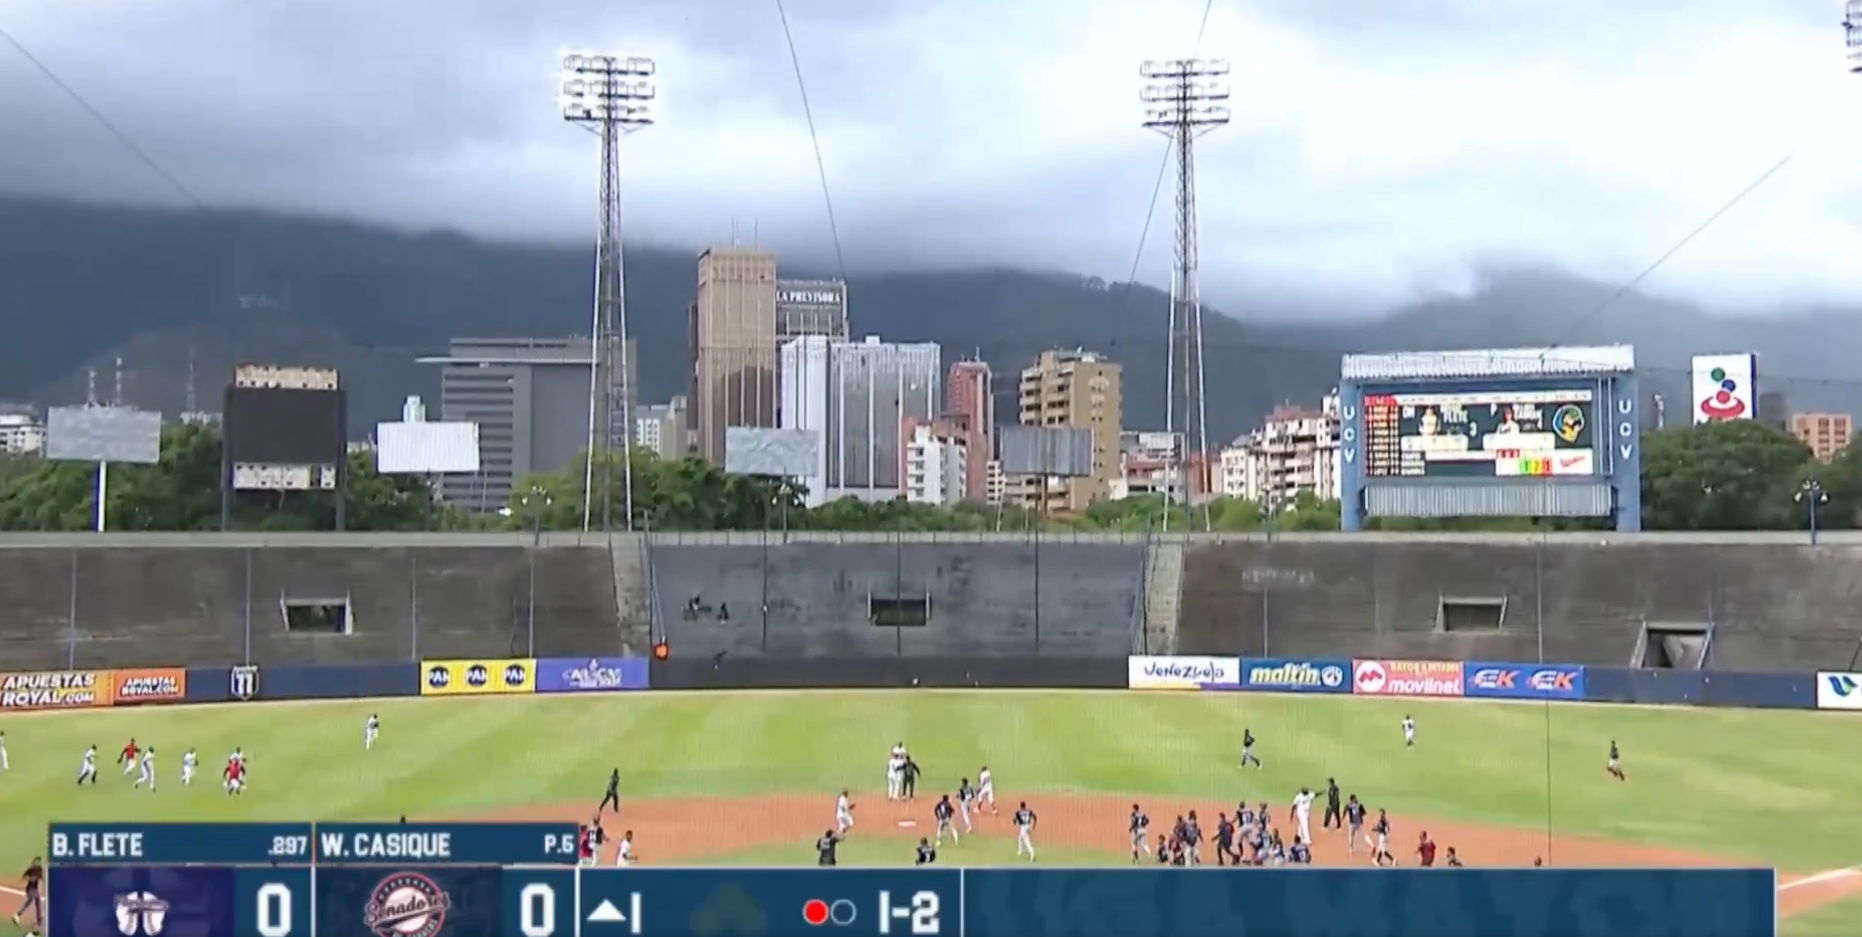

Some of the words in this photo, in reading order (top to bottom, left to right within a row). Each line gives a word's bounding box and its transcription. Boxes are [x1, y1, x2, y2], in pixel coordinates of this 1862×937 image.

[790, 291, 841, 303] PREVISORA
[2, 673, 96, 690] APUESTAS
[126, 676, 176, 686] APUESTAS
[1388, 677, 1461, 694] movilnet
